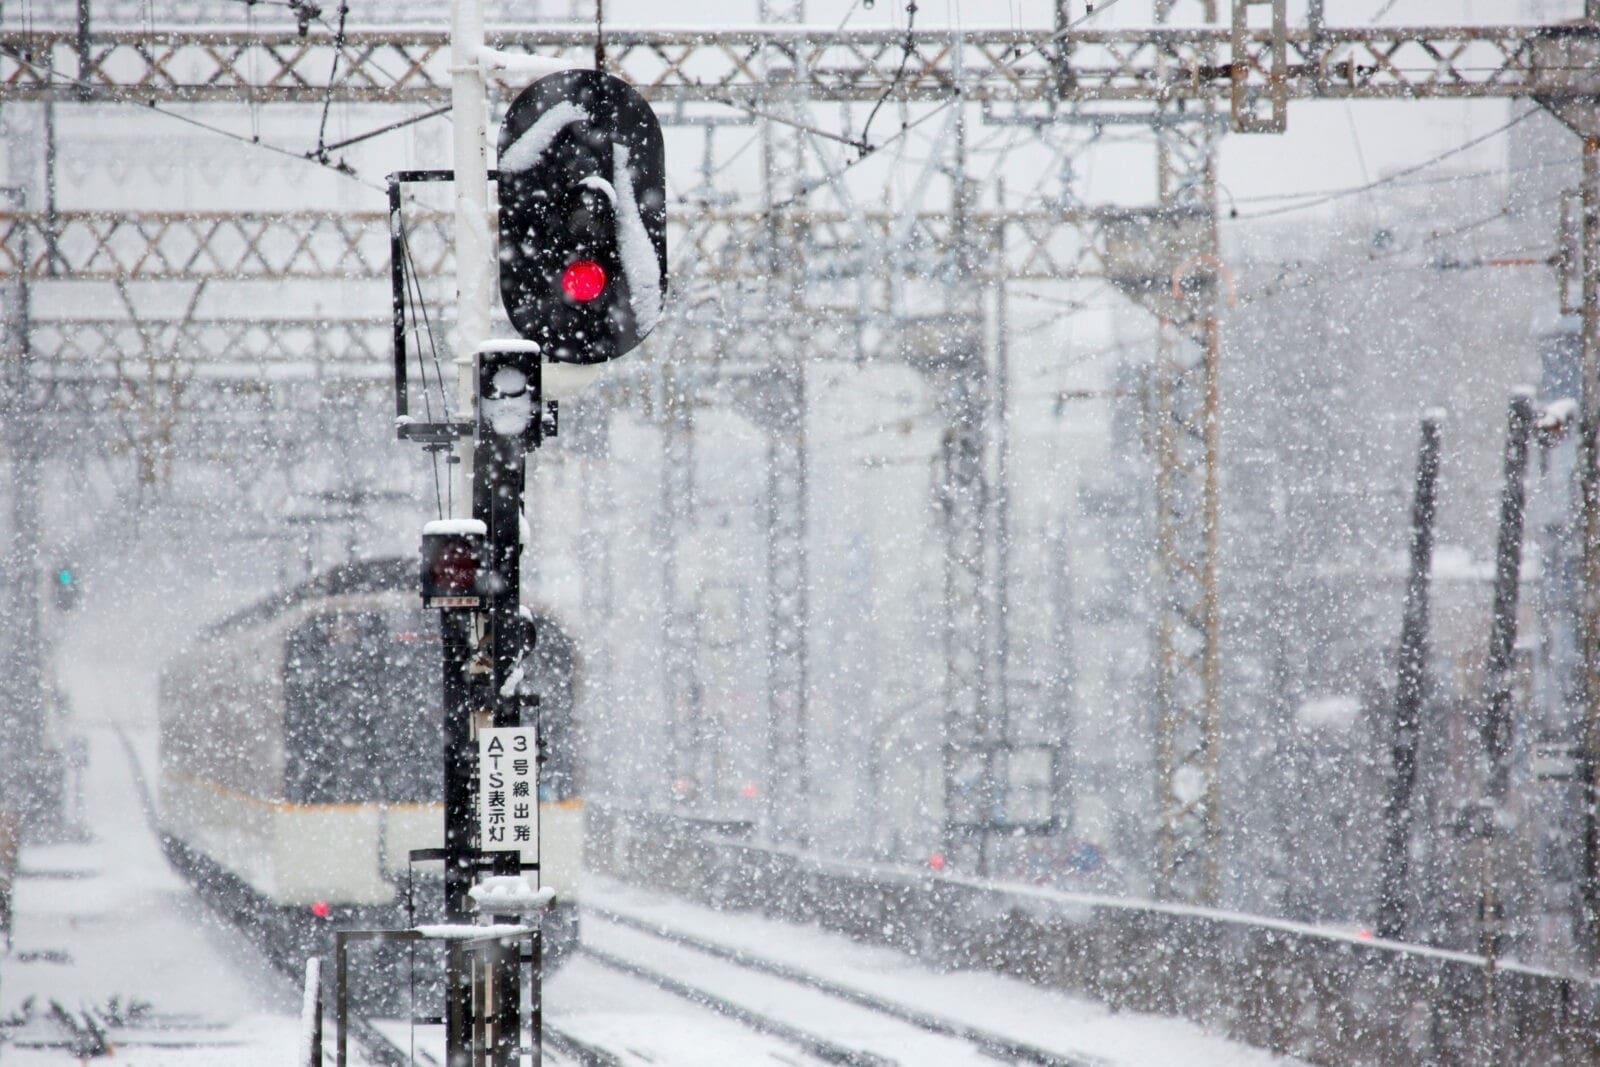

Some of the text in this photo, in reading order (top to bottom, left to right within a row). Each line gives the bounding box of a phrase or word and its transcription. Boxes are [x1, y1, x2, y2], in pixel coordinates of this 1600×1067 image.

[487, 736, 505, 842] ATS表示灯
[512, 735, 530, 842] 3号線出発
